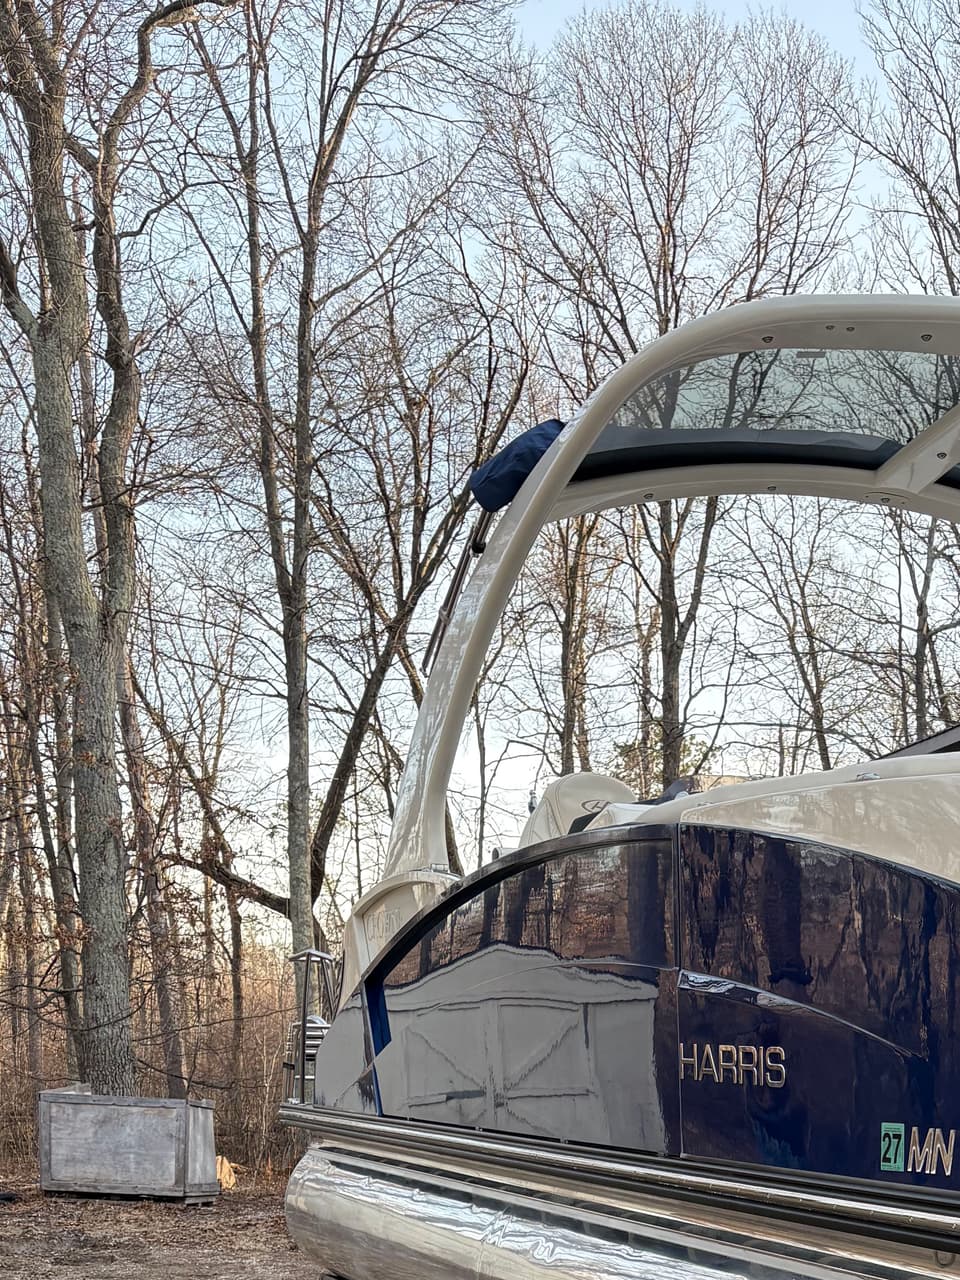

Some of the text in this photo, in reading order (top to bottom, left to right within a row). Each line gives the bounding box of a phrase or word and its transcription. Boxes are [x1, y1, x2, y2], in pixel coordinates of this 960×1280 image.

[679, 1042, 786, 1088] HARRIS
[882, 1132, 902, 1164] 27
[907, 1126, 956, 1176] MN
